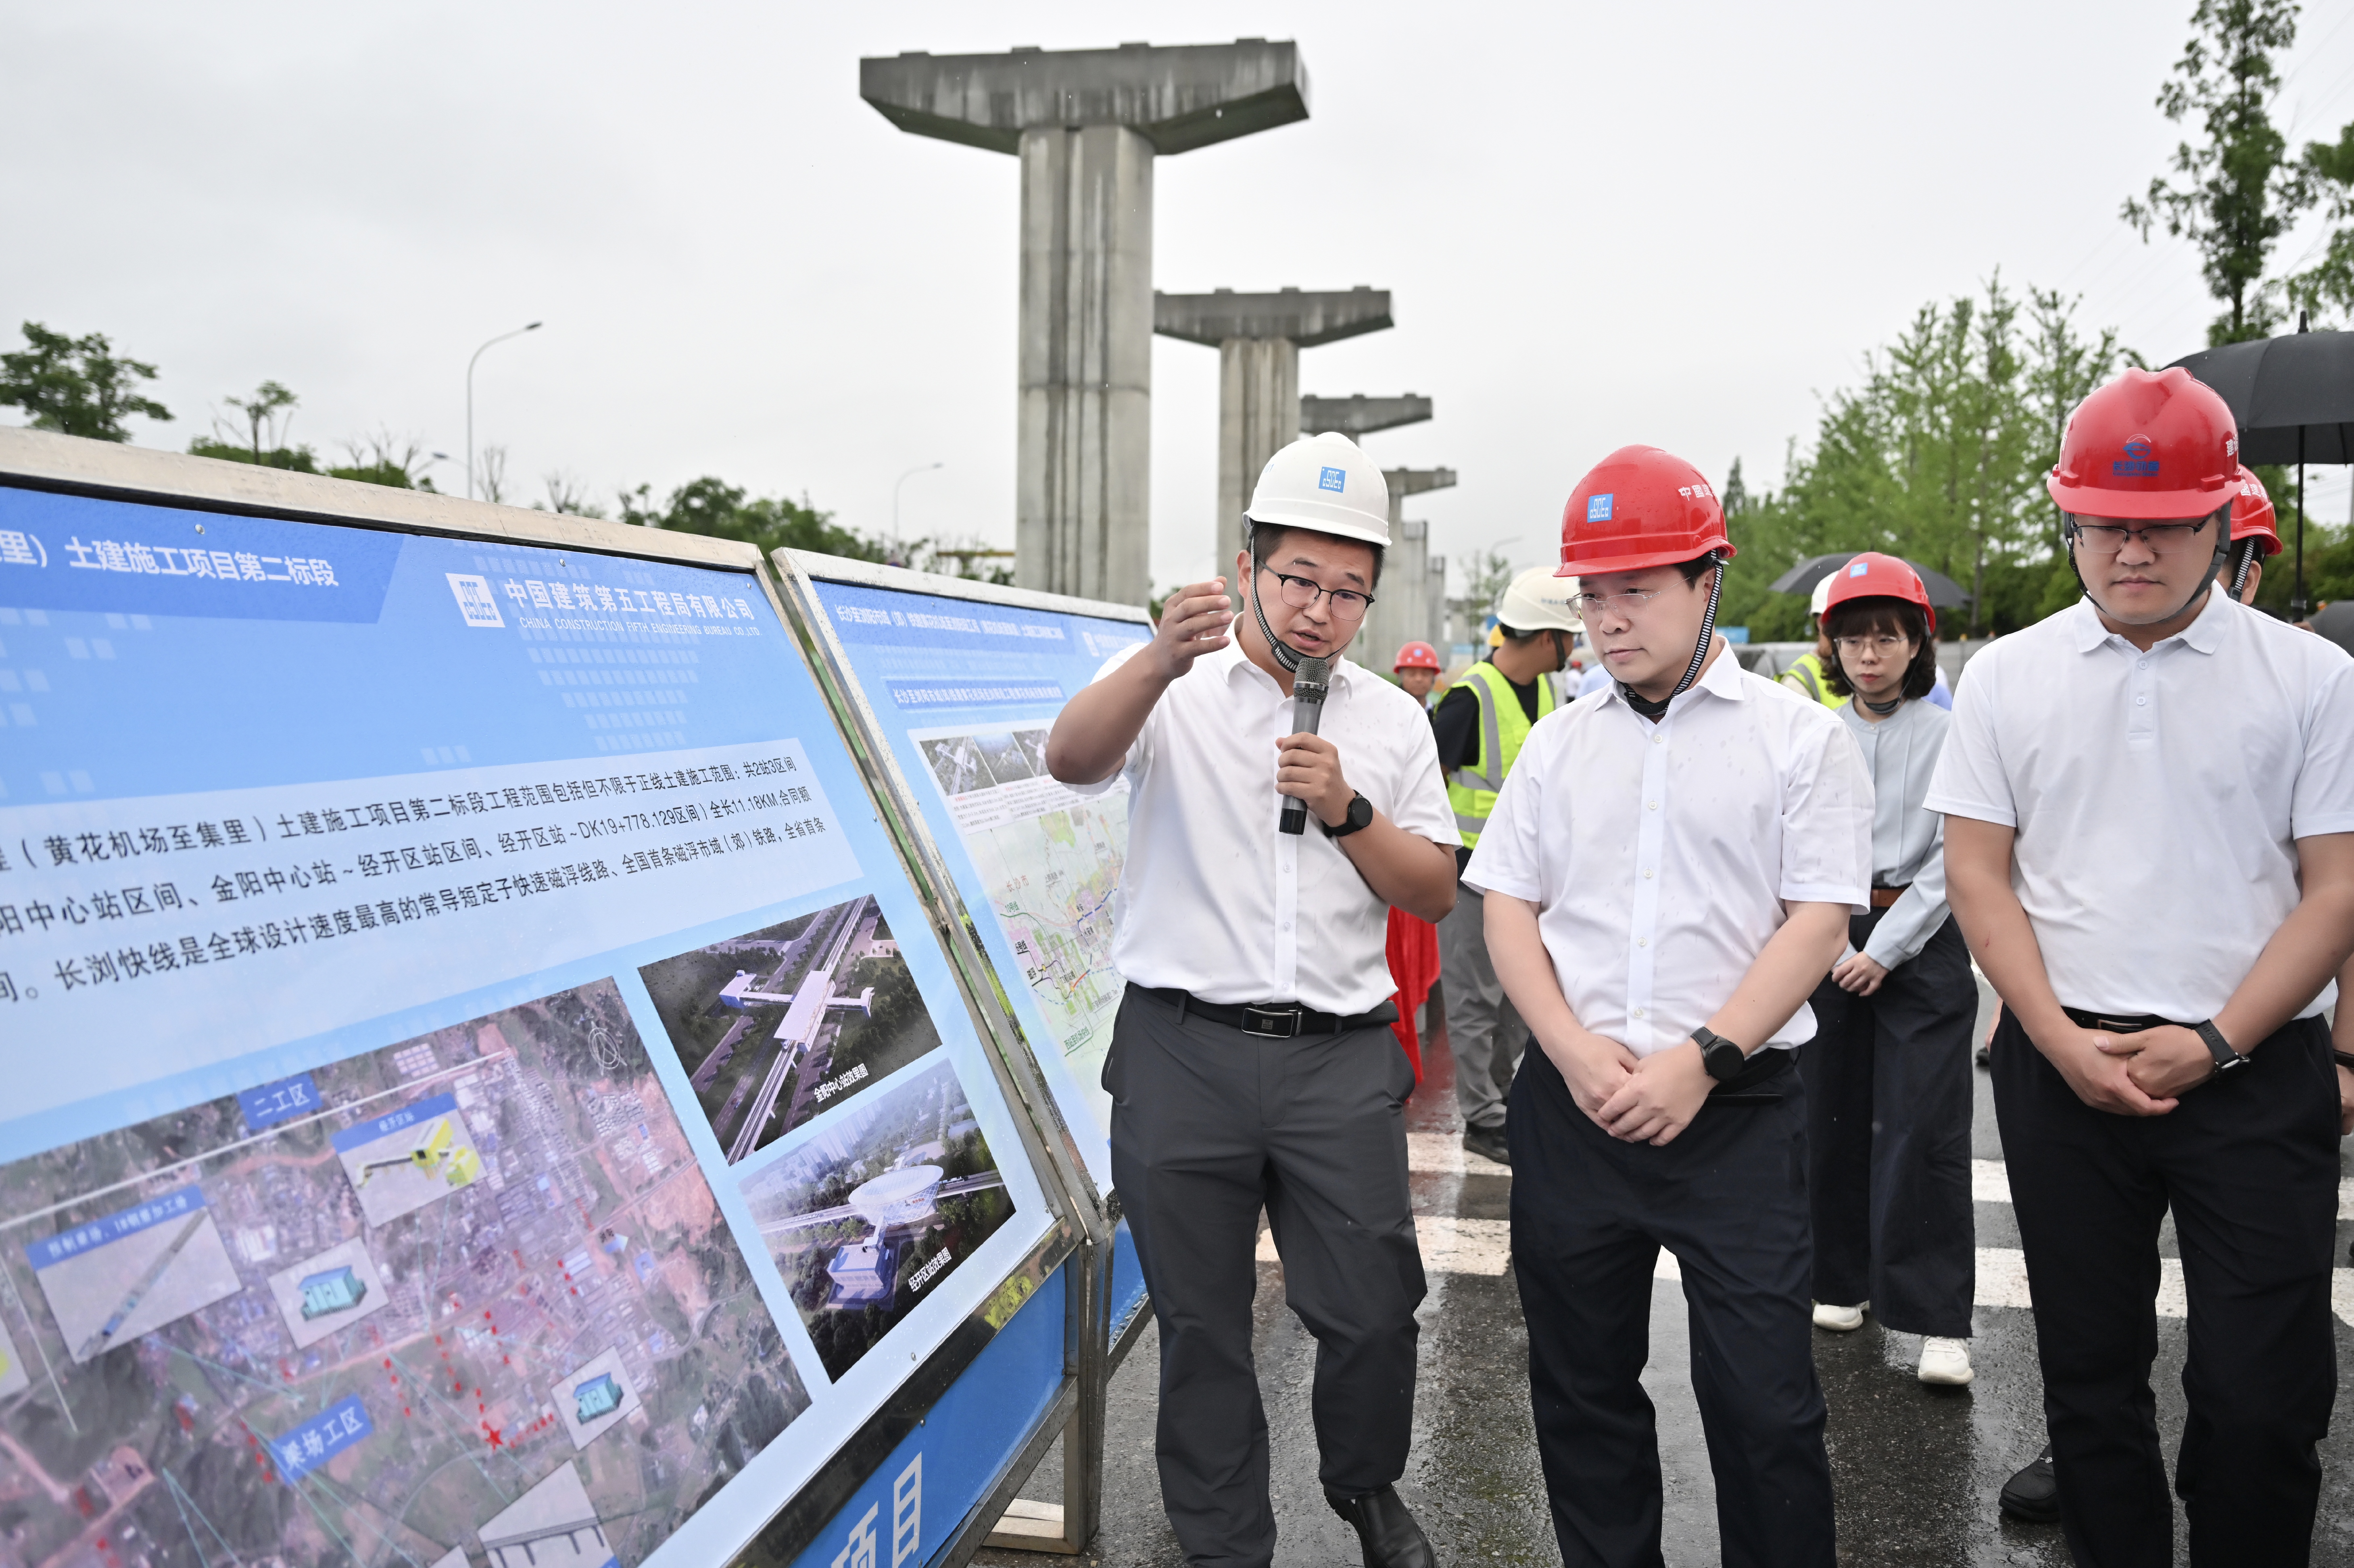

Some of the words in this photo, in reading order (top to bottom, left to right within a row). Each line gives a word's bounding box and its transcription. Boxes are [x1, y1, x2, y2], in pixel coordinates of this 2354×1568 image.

[0, 530, 338, 587] 里）土建施工项目第二标段
[504, 578, 754, 620] 中国建筑第五工程局有限公司
[520, 617, 551, 629] CHINA
[555, 618, 624, 632] CONSTRUCTION
[626, 621, 649, 633] FIFTH
[651, 623, 702, 635] ENGINEERING
[703, 626, 732, 635] BUREAU
[1005, 900, 1019, 913] 10号线
[1015, 939, 1028, 952] 6号线
[254, 1083, 310, 1117] 二工区
[814, 1063, 868, 1103] 金阳中心站效果图
[908, 1246, 952, 1293] 经开区站效果图
